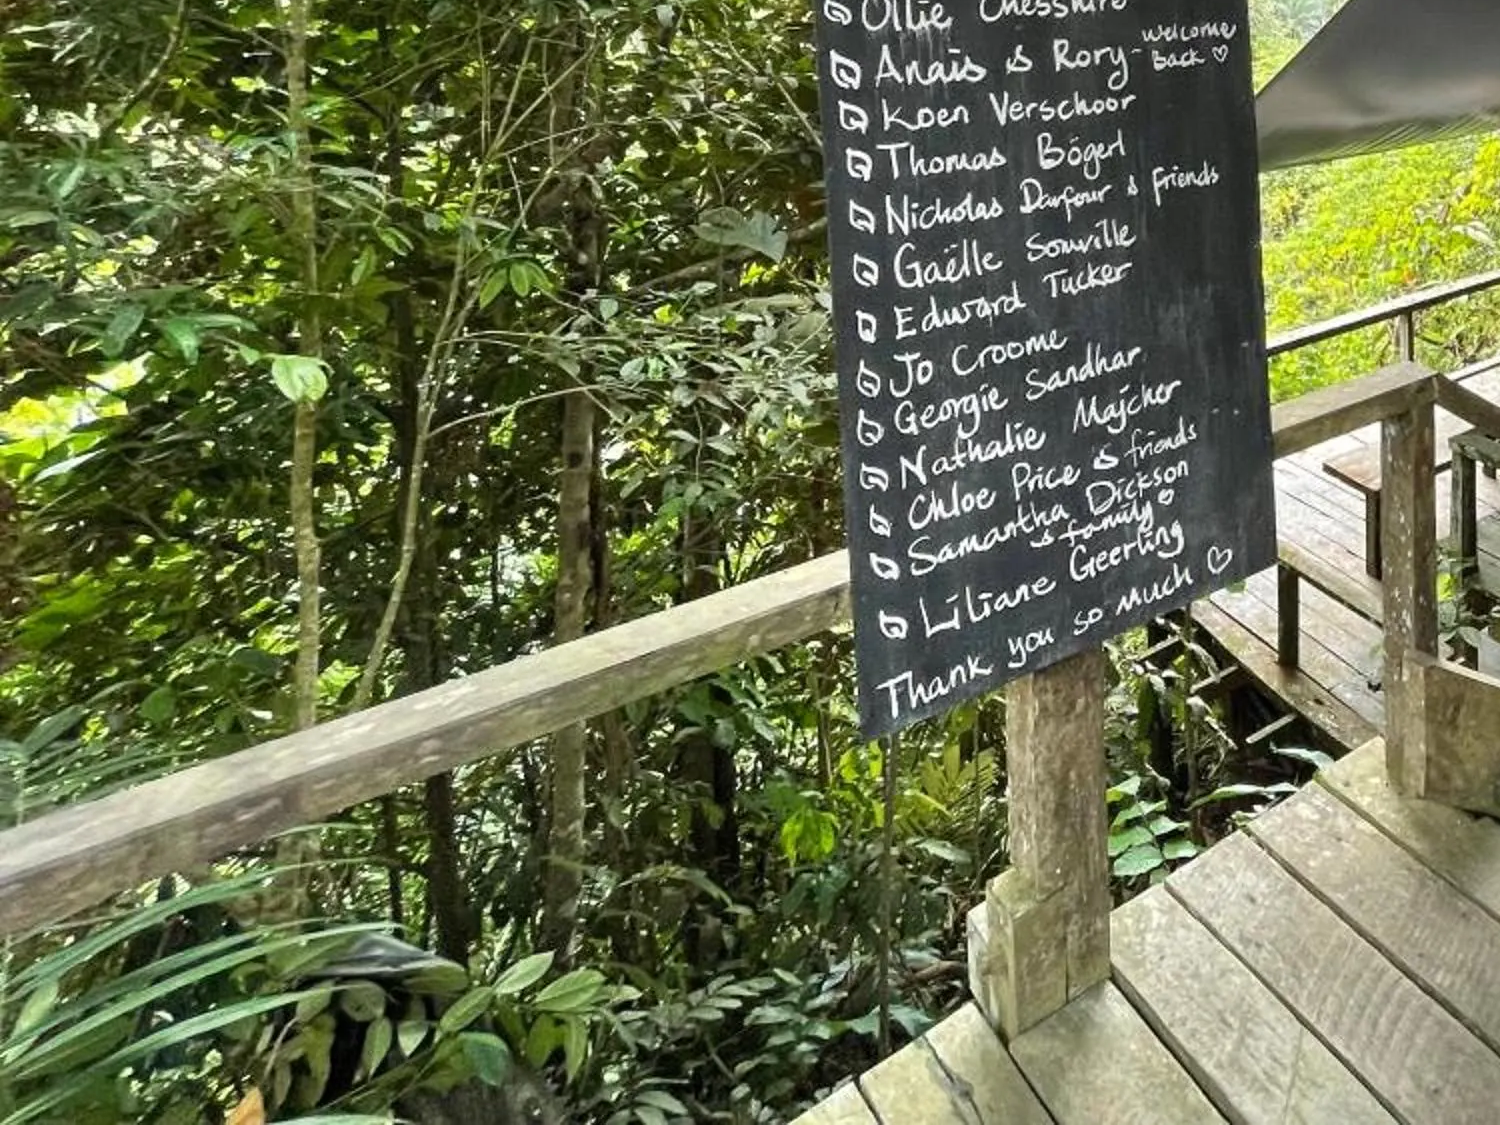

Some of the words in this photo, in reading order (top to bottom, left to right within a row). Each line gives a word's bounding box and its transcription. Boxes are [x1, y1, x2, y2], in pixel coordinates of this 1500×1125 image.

[989, 92, 1136, 127] Verschoor
[877, 142, 1006, 179] Thomas
[885, 192, 1004, 236] Nicholas
[894, 241, 1003, 288] Gaëlle
[894, 282, 1026, 340] Edward
[1044, 261, 1133, 299] Tucker
[889, 352, 933, 398] Jo
[953, 327, 1068, 375] Croome
[894, 383, 1009, 439] Georgie
[899, 423, 1046, 491] Nathalie
[907, 482, 997, 531] Chloe
[1012, 461, 1081, 501] Price
[1124, 416, 1197, 467] friends
[910, 503, 1070, 575] Samantha
[1085, 460, 1190, 517] Dickson
[1059, 500, 1154, 548] family
[1069, 519, 1185, 582] Geerling
[876, 653, 995, 719] Thank
[1007, 630, 1055, 669] you
[1073, 608, 1102, 636] so
